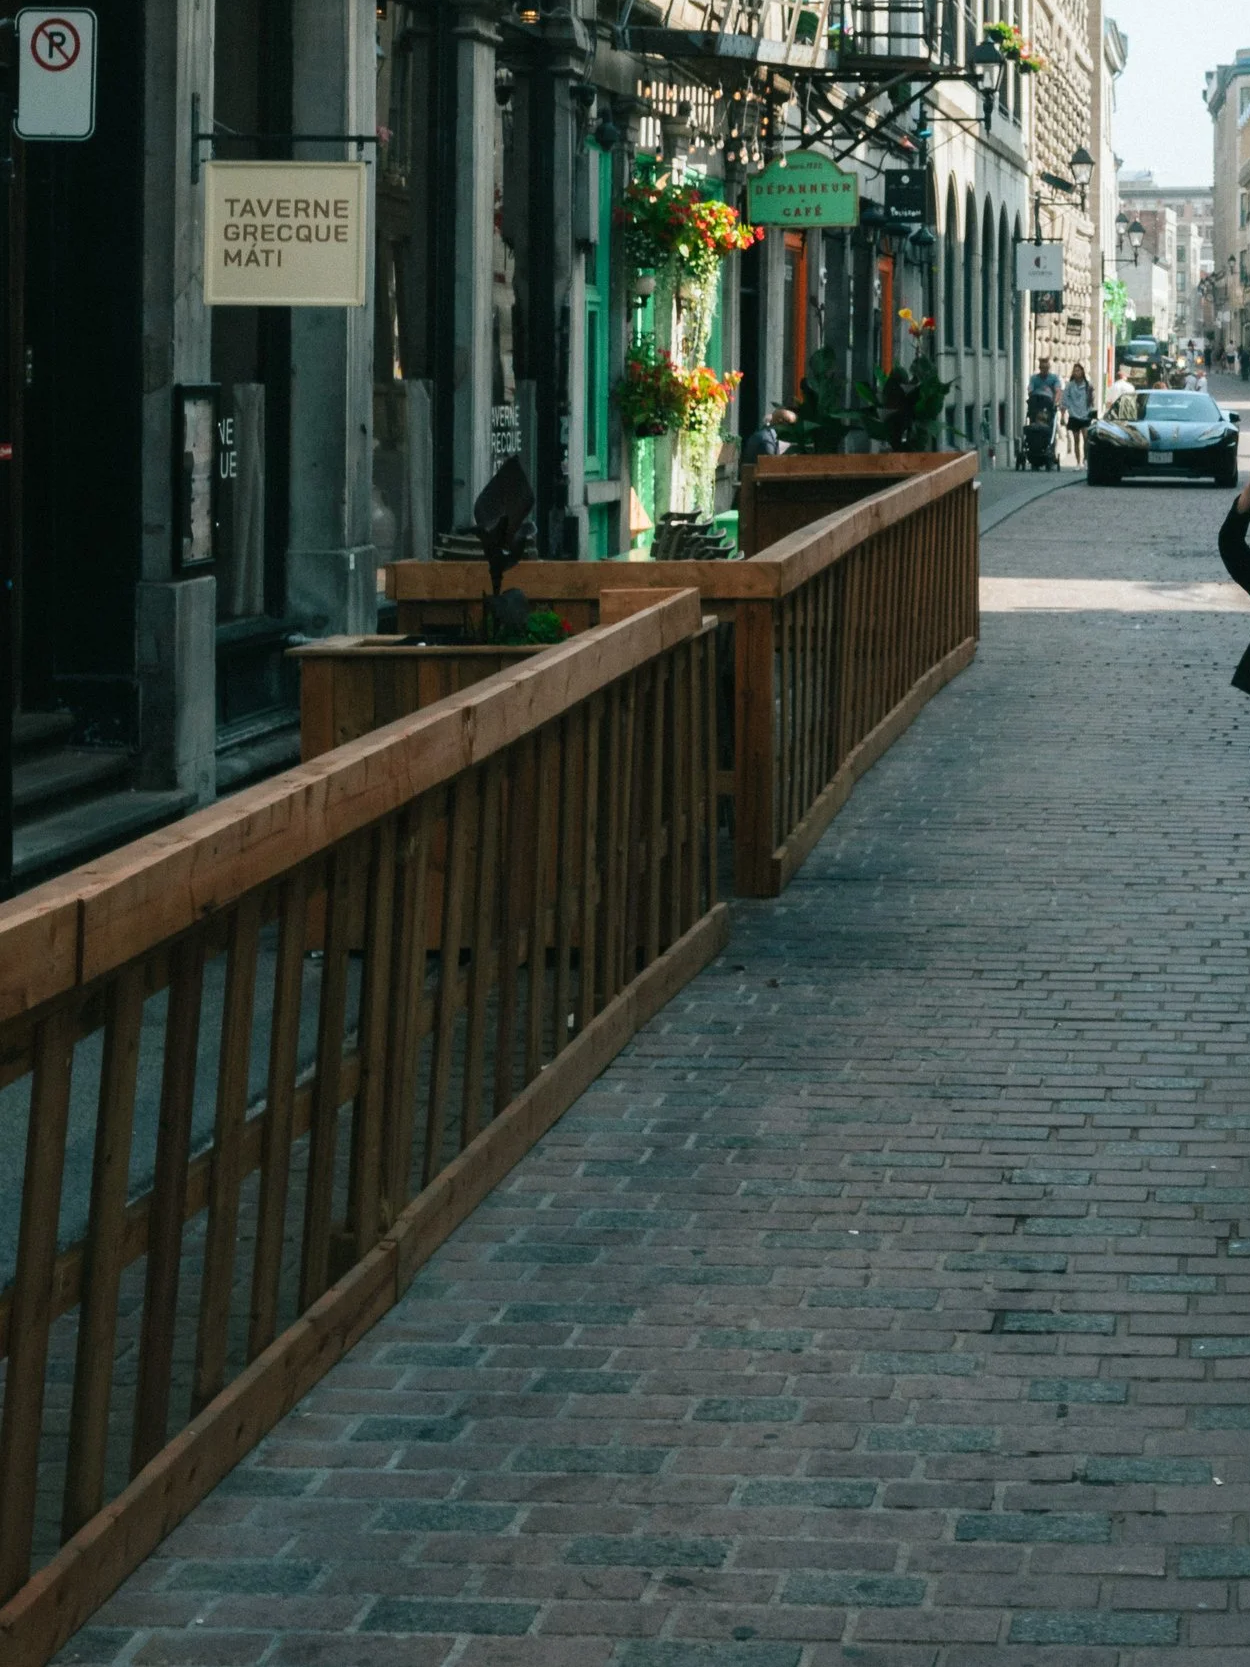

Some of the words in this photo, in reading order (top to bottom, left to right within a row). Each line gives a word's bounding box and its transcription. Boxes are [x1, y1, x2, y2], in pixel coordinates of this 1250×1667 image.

[755, 182, 851, 195] DÉPANNEUR
[224, 198, 349, 219] TAVERNE
[783, 203, 822, 217] CAFÉ
[223, 224, 349, 243] GRECQUE
[223, 243, 282, 268] MÁTI
